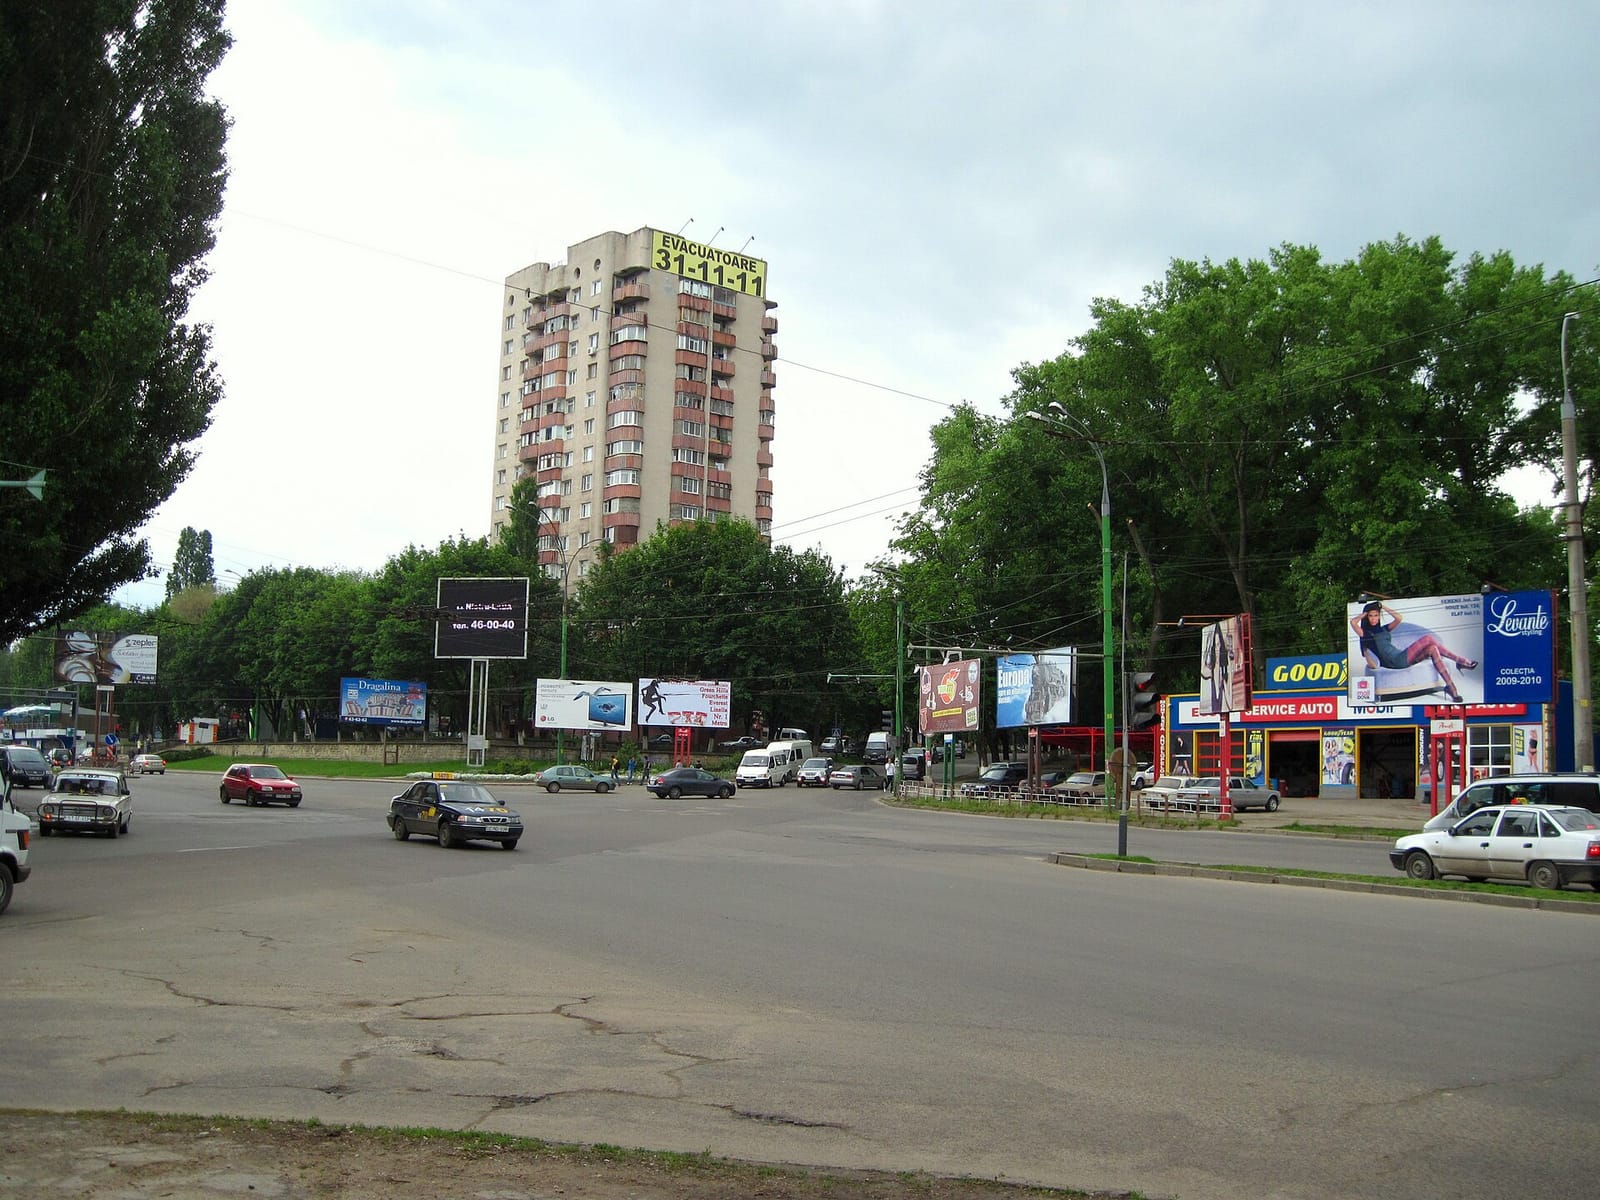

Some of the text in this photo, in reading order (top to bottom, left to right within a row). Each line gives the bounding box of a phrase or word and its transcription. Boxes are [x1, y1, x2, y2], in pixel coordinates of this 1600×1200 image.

[662, 234, 757, 273] EVACUATOARE
[656, 248, 762, 297] 31-11-11
[1487, 595, 1549, 637] Levante
[471, 620, 515, 629] 46-00-40
[359, 680, 401, 691] Dragalina
[998, 668, 1030, 688] Europa
[1495, 676, 1542, 686] 2009-2010
[1299, 703, 1333, 715] AUTO
